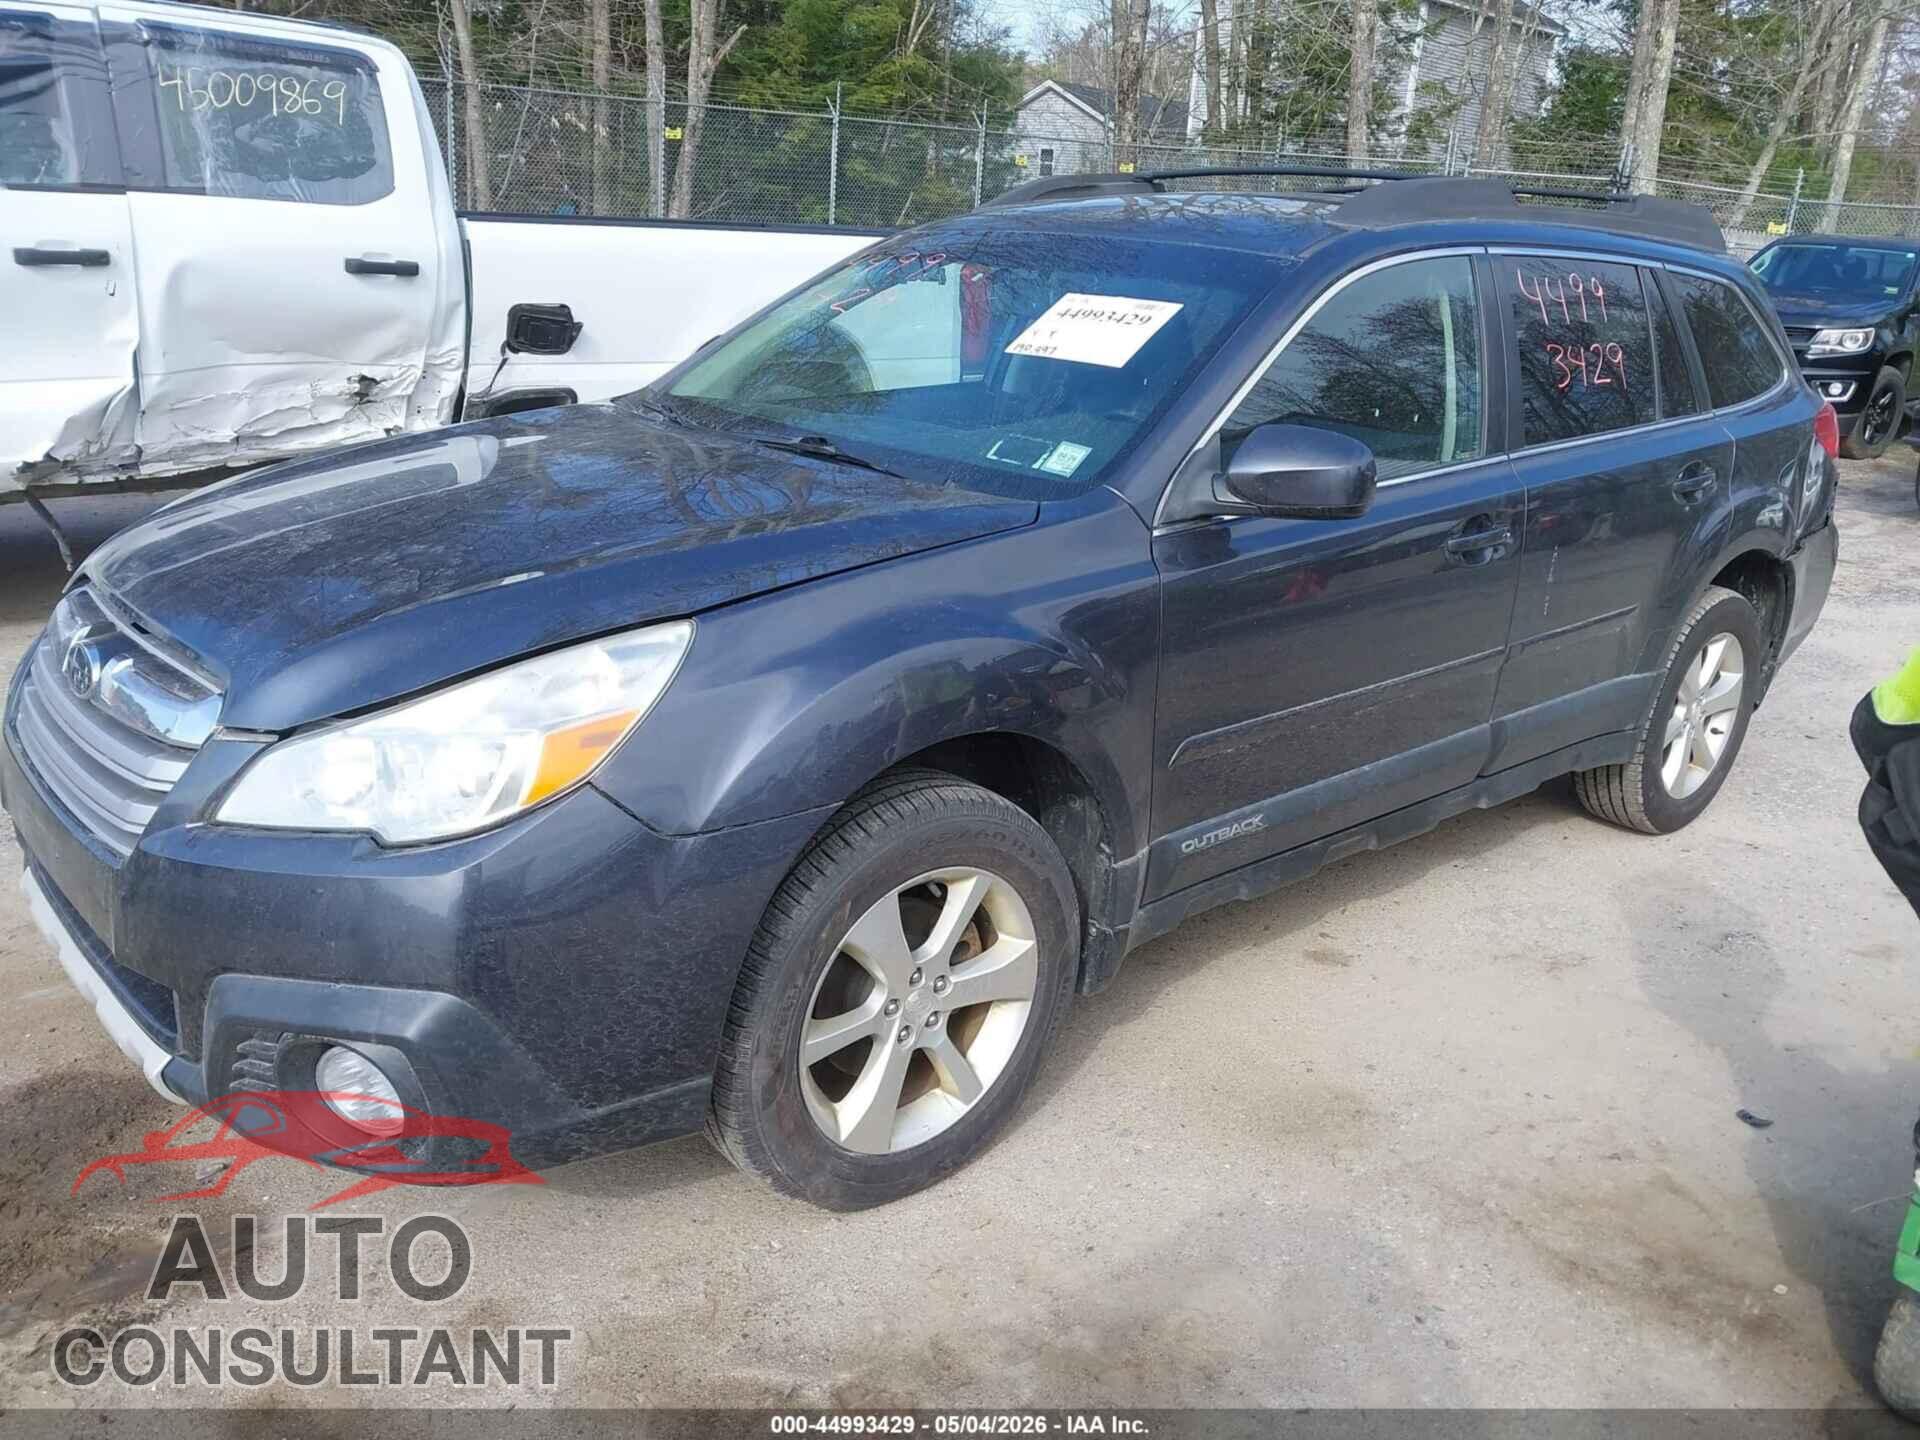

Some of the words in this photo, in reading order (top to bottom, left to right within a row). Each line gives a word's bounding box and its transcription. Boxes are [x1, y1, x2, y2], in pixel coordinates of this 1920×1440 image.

[157, 64, 346, 127] 45009869
[1056, 307, 1153, 326] 44993429
[1516, 268, 1608, 326] 4499
[1546, 342, 1628, 390] 3429
[1181, 814, 1264, 853] OUTBACK
